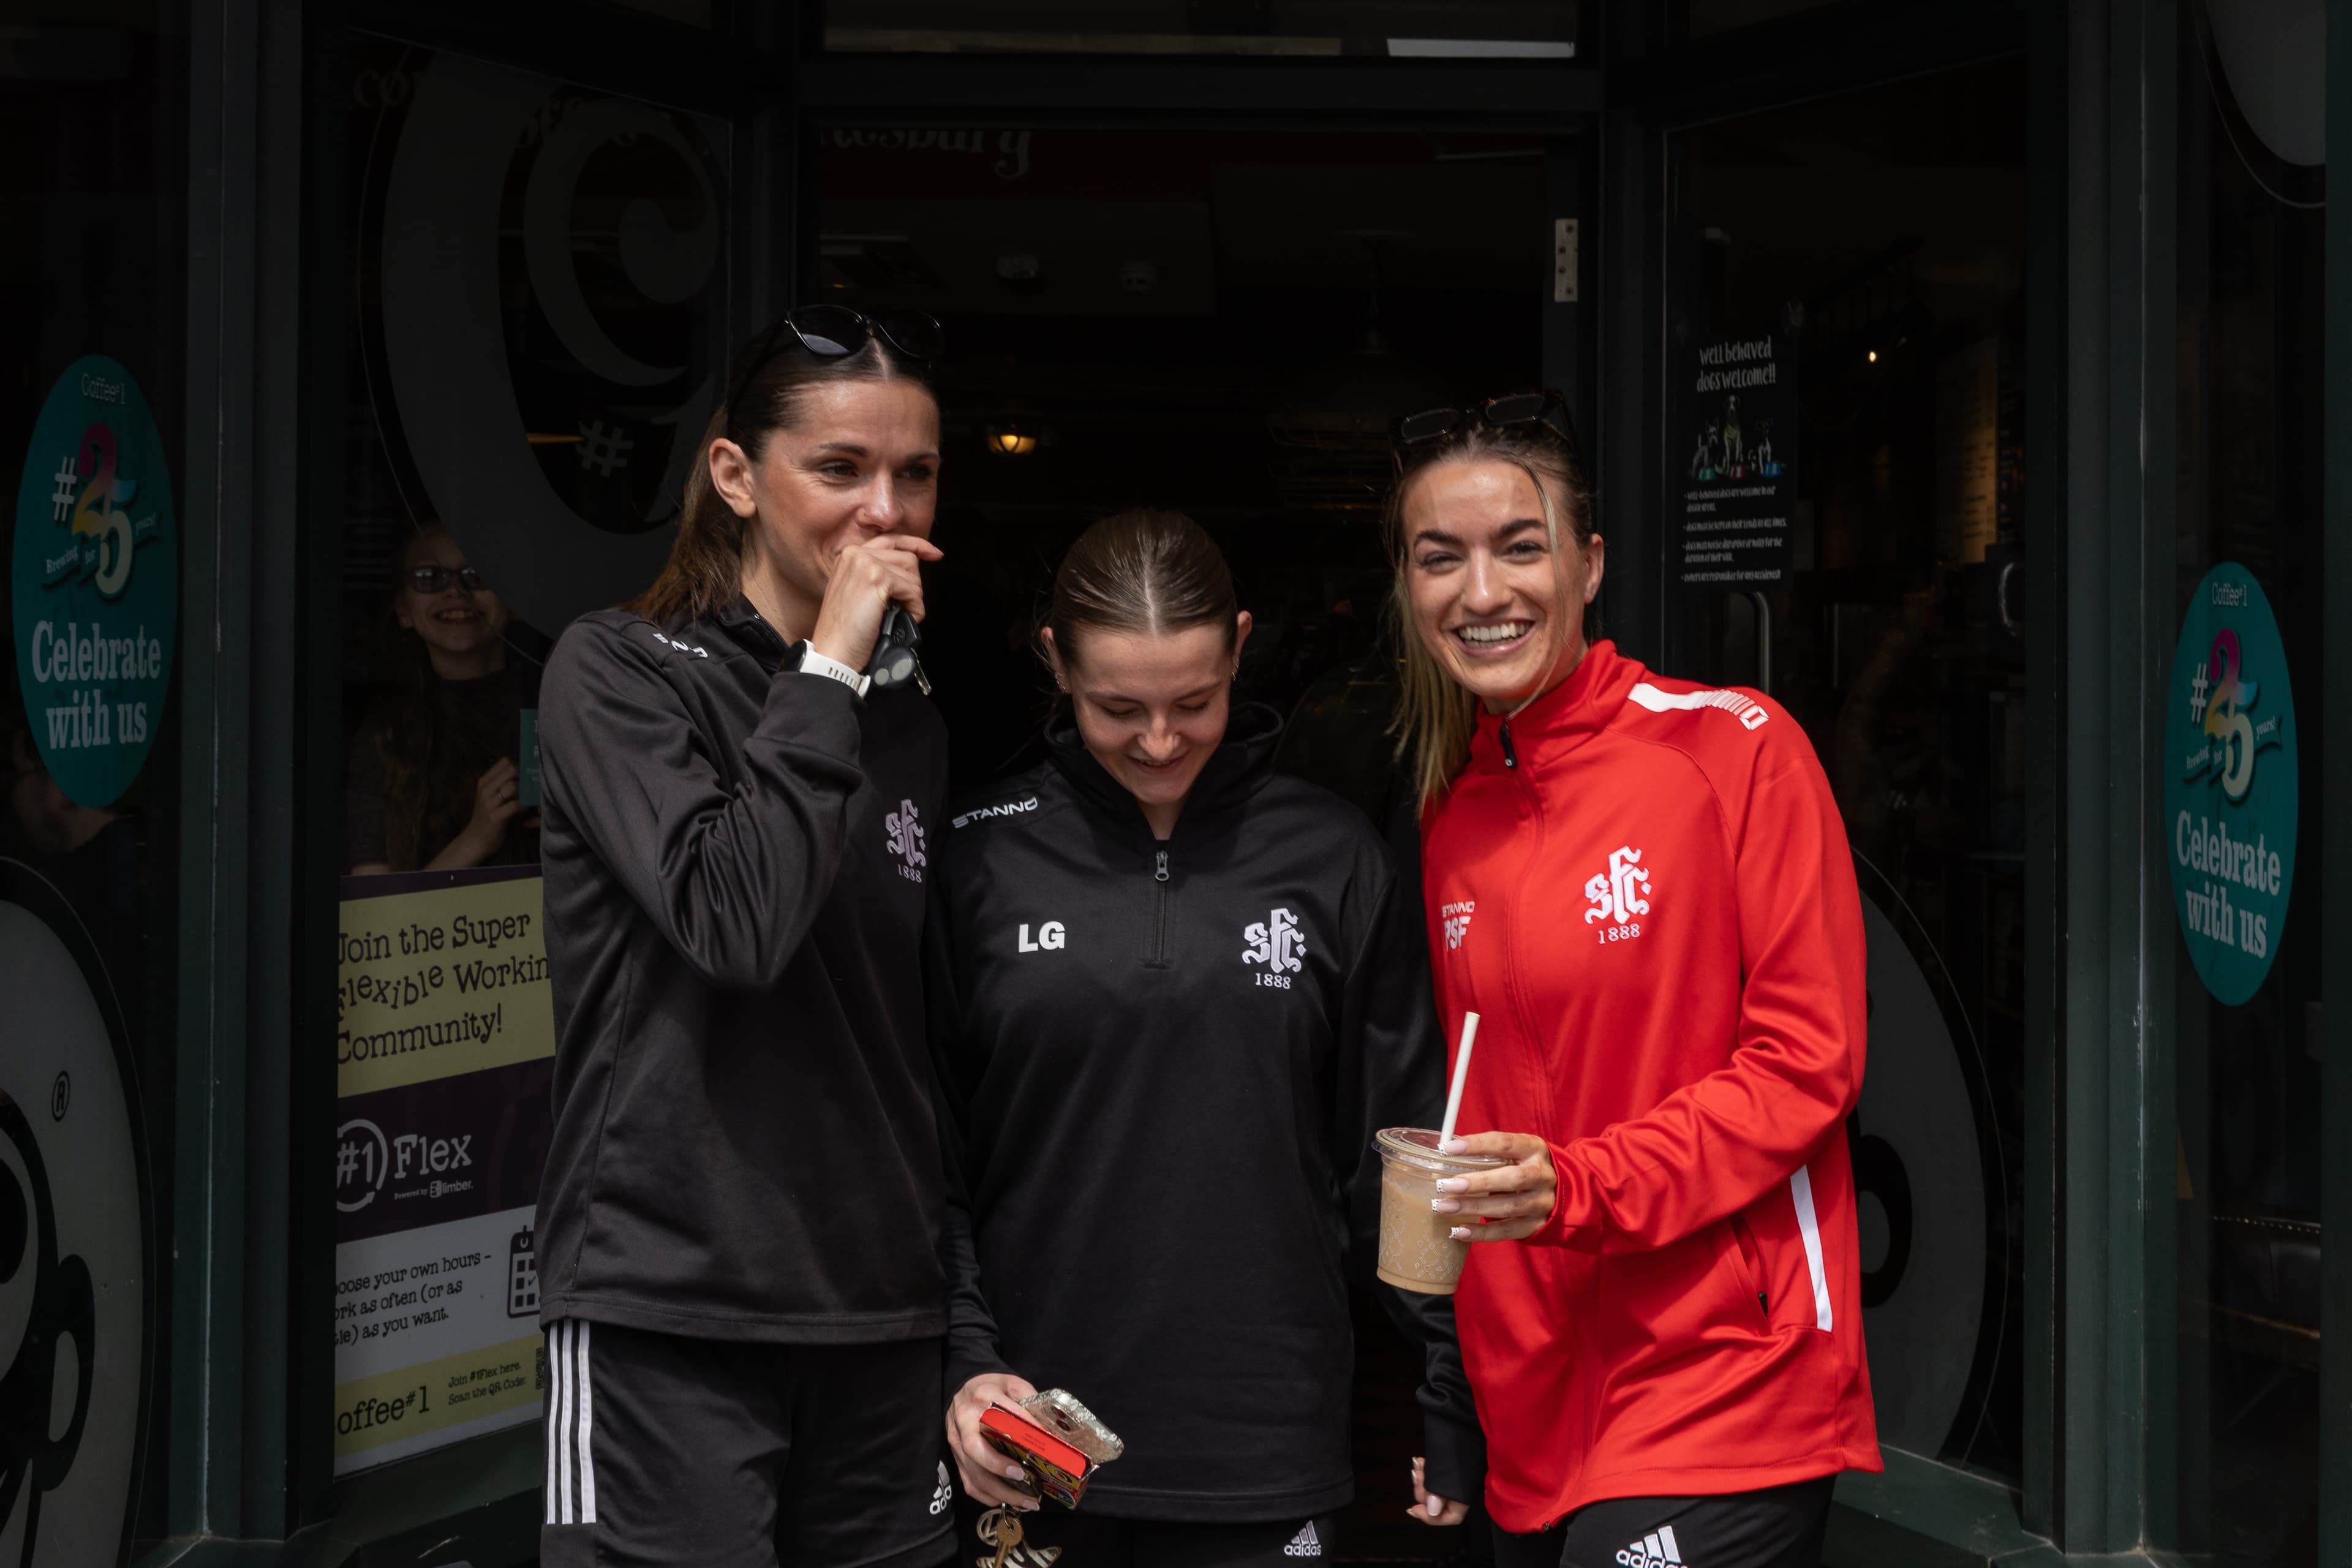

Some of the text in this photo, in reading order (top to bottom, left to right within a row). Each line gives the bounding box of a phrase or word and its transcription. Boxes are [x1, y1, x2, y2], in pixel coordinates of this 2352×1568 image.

[32, 620, 162, 683] Celebrate
[46, 688, 148, 750] with us
[952, 796, 1039, 829] STANNO
[2176, 809, 2282, 897] Celebrate
[897, 863, 922, 883] 1888
[1018, 921, 1066, 953] LG
[1597, 922, 1641, 944] 1888
[2185, 879, 2267, 960] with us
[338, 914, 531, 965] Join the Super
[1254, 972, 1292, 990] 1888
[338, 1003, 502, 1065] Community!
[393, 1134, 473, 1180] Flex
[334, 1276, 370, 1295] oose
[374, 1268, 407, 1290] your
[411, 1262, 439, 1279] own
[443, 1252, 481, 1272] hours
[360, 1299, 377, 1315] as
[381, 1291, 417, 1310] often
[421, 1285, 444, 1304] (or
[447, 1280, 462, 1296] as
[362, 1323, 379, 1339] as
[382, 1316, 408, 1338] you
[413, 1306, 449, 1327] want.
[1284, 1544, 1322, 1557] adidas
